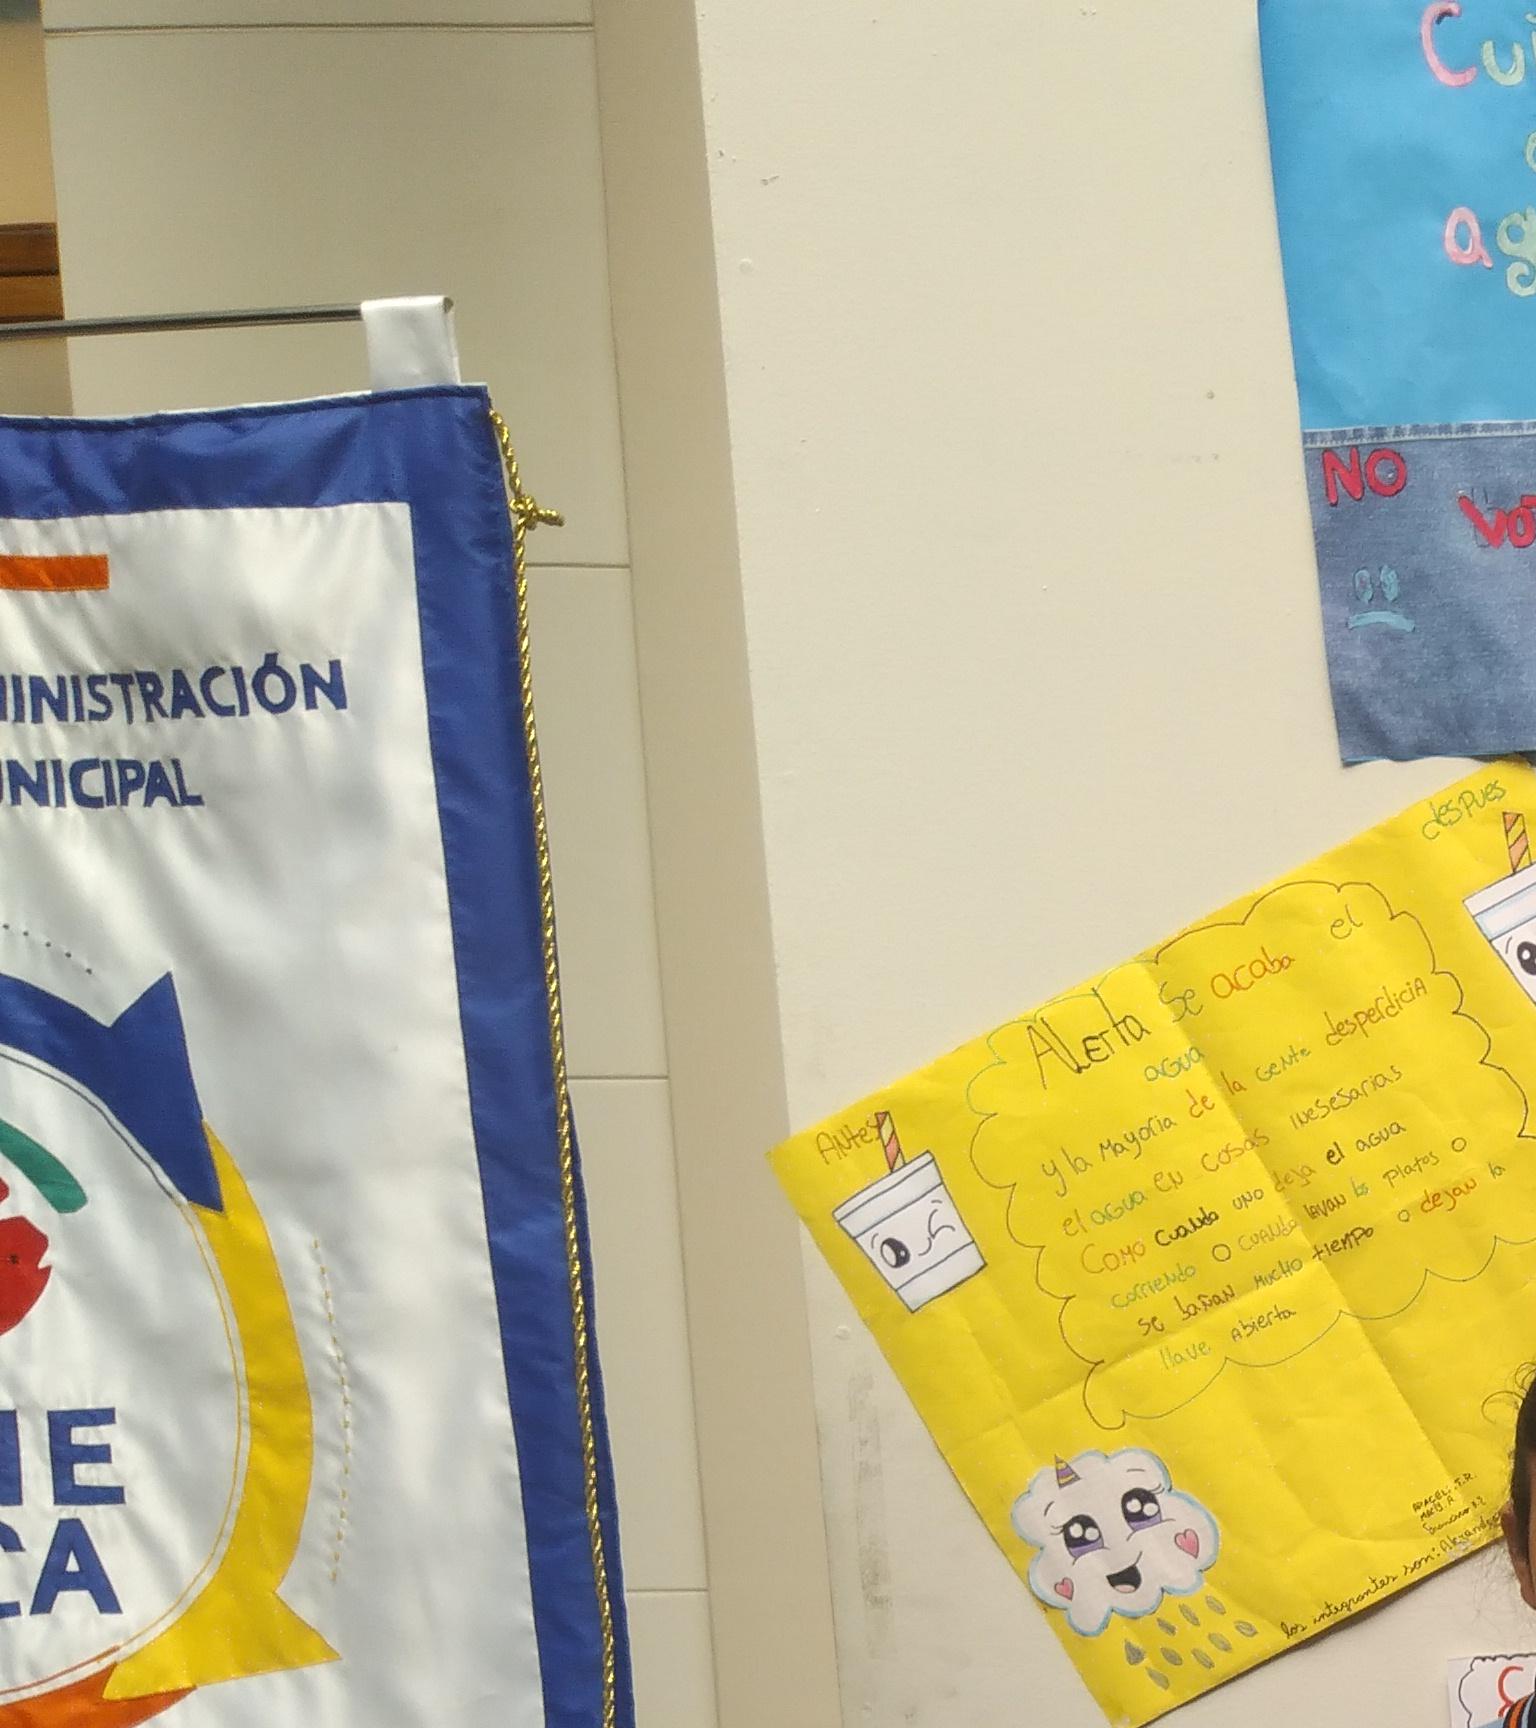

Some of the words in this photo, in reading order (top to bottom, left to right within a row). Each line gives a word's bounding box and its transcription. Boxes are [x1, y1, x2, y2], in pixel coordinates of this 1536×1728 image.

[1321, 446, 1408, 507] NO
[0, 652, 348, 725] INISTRACIÓN
[0, 757, 205, 809] NICIPAL
[1060, 1146, 1094, 1176] la
[1185, 1088, 1216, 1119] de
[1220, 1070, 1248, 1097] la
[1325, 1140, 1346, 1167] el
[1061, 1208, 1089, 1237] el
